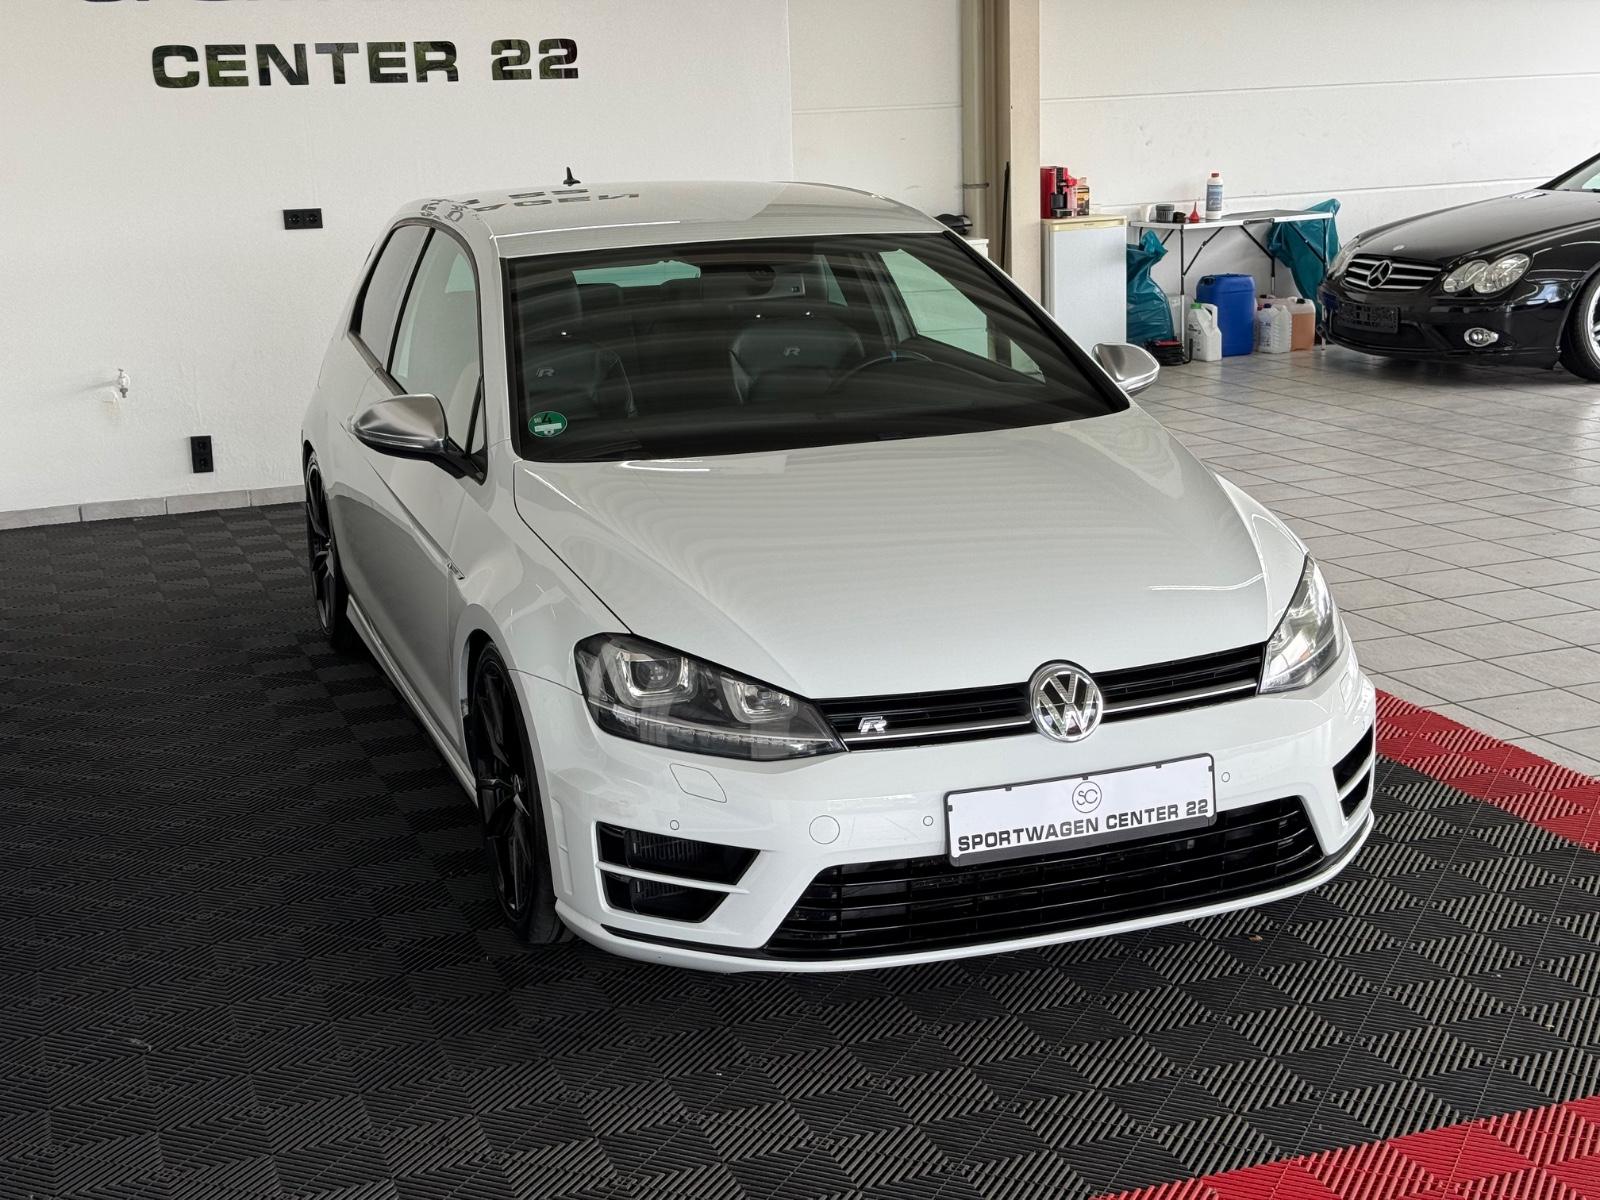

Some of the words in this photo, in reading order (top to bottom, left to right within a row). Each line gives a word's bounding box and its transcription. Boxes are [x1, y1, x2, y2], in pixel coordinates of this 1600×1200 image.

[152, 41, 459, 88] CENTER
[491, 38, 579, 81] 22
[541, 413, 552, 424] 4
[858, 716, 887, 734] R
[1076, 788, 1098, 806] SC
[958, 816, 1100, 852] SPORTWAGEN
[1105, 803, 1179, 830] CENTER
[1186, 798, 1208, 816] 22
